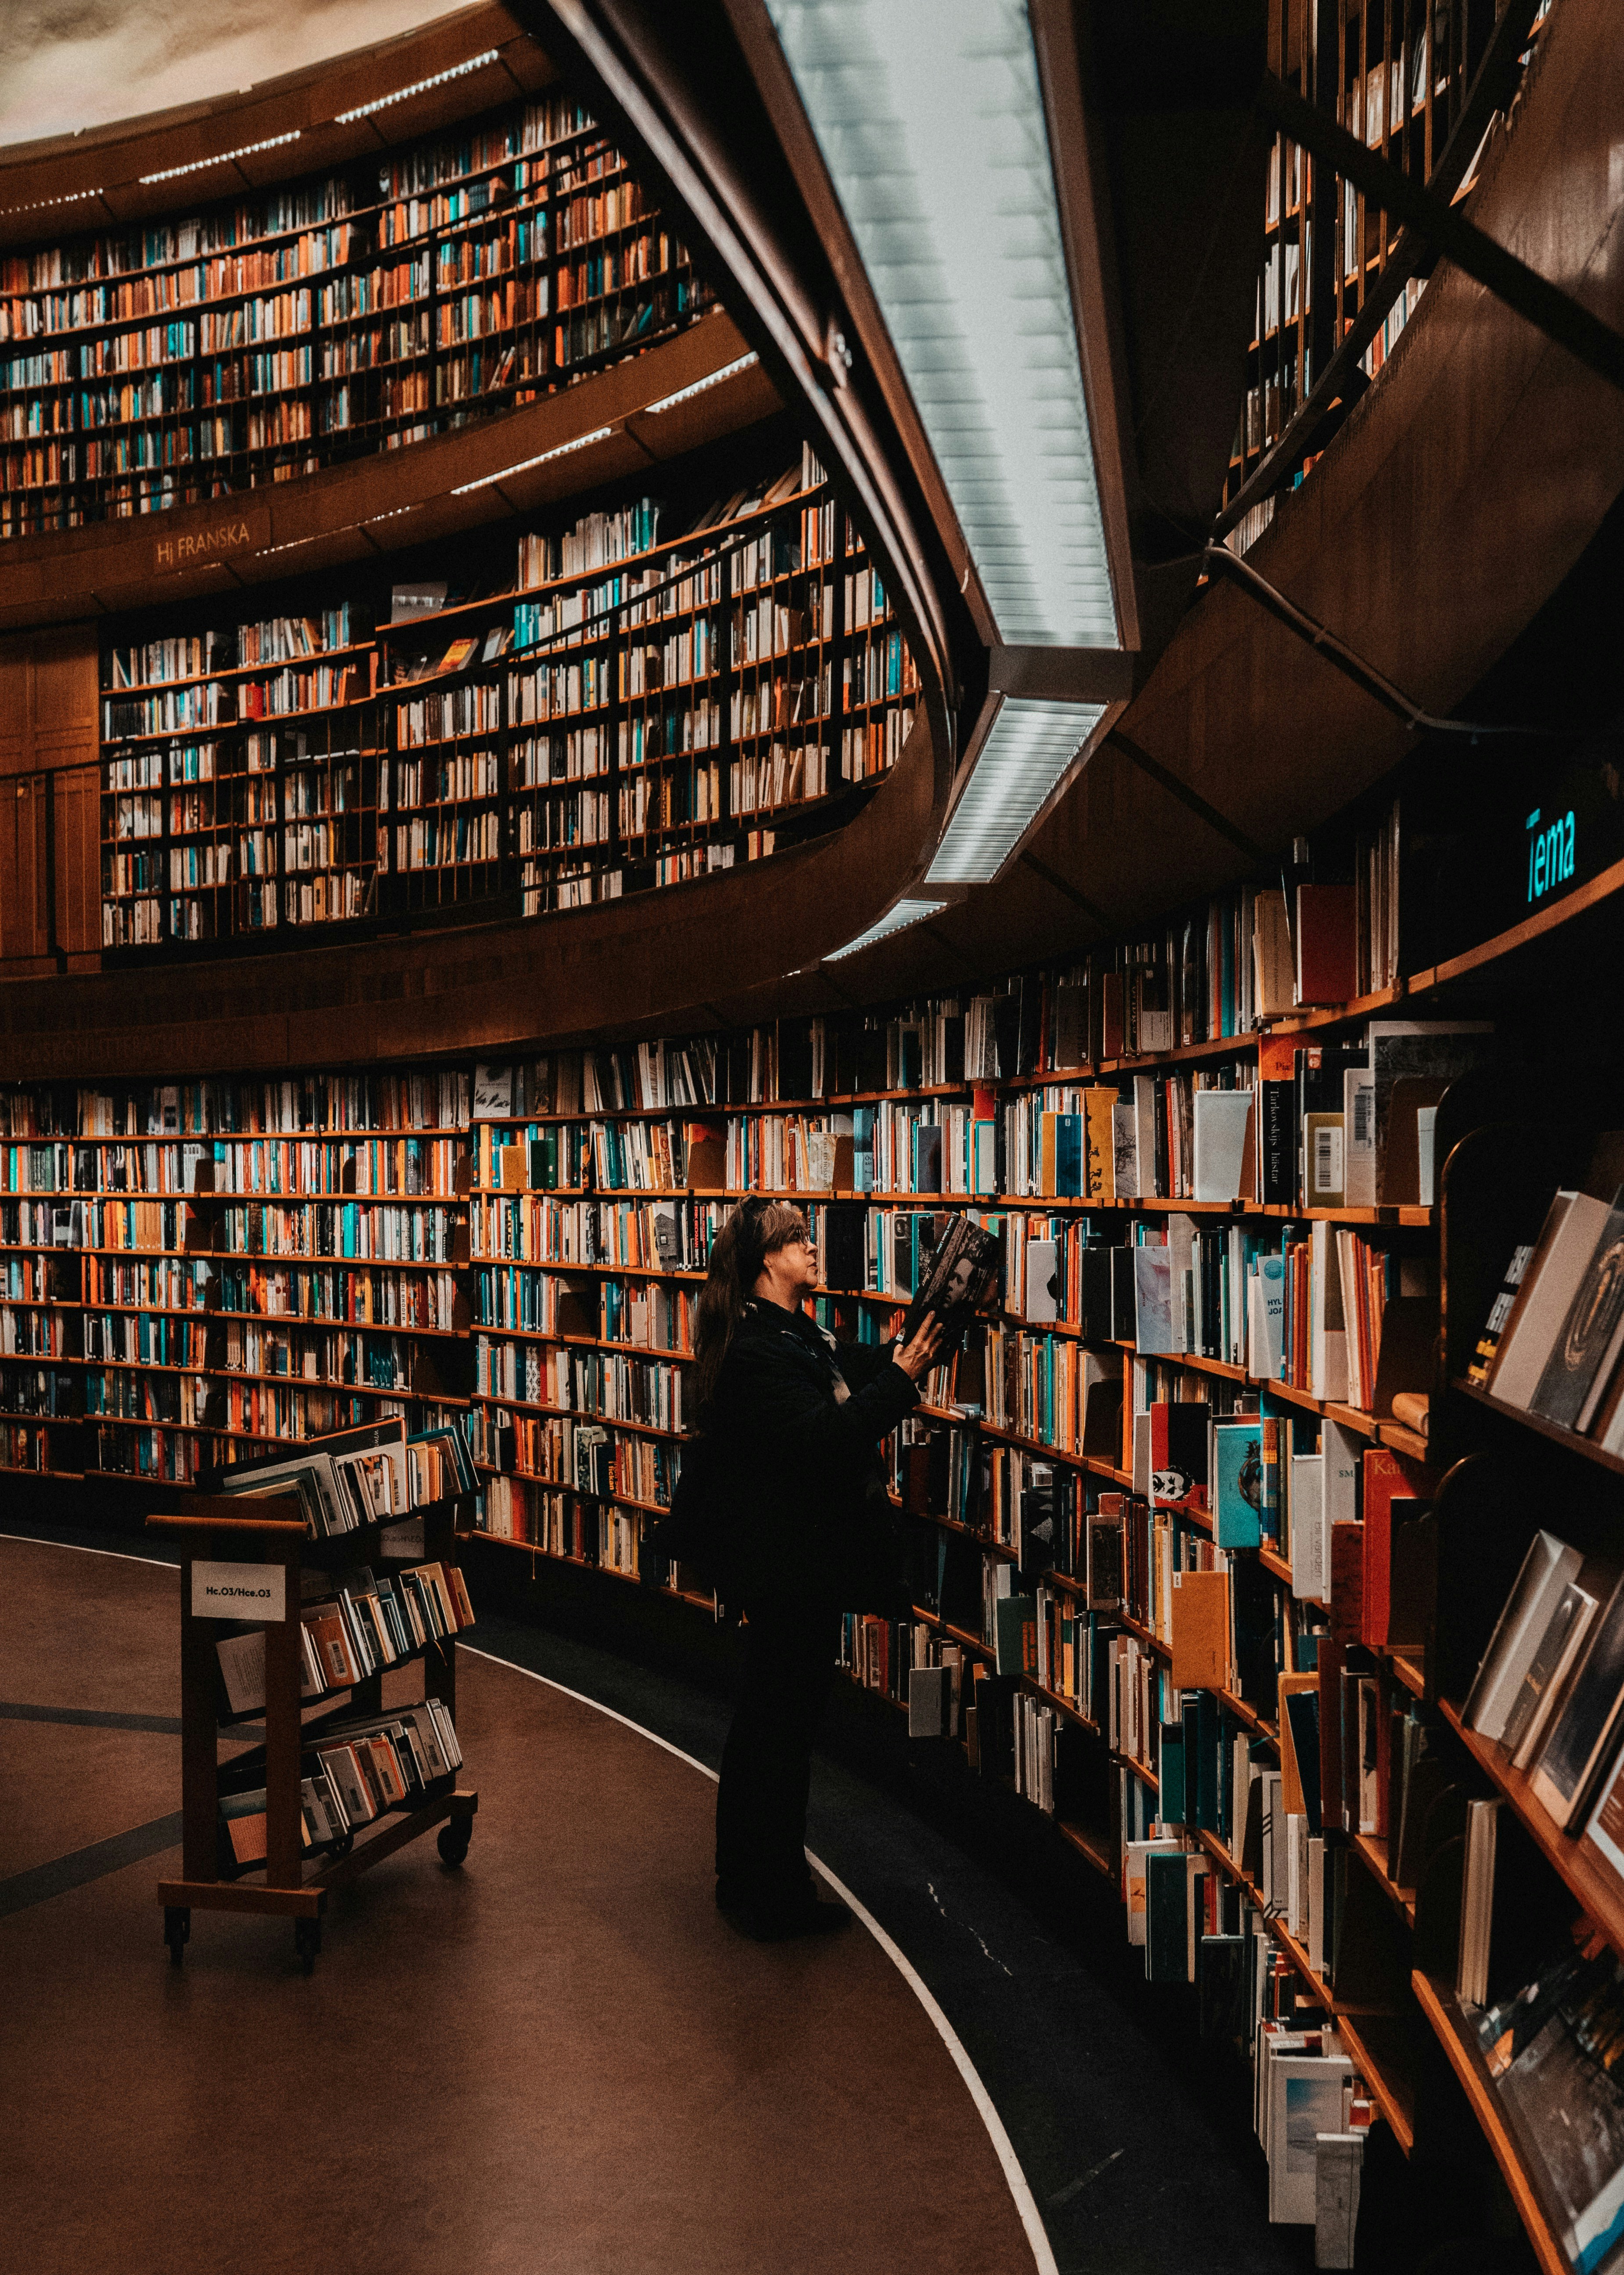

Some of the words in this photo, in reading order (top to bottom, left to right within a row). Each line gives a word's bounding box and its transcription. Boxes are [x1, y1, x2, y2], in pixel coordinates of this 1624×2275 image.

[178, 522, 250, 559] FRANSKA
[1526, 808, 1575, 902] Tema
[1268, 1087, 1281, 1146] Tarkovskijs
[1270, 1152, 1281, 1184] hästar
[940, 1229, 949, 1242] Tobias
[946, 1217, 954, 1230] Martin
